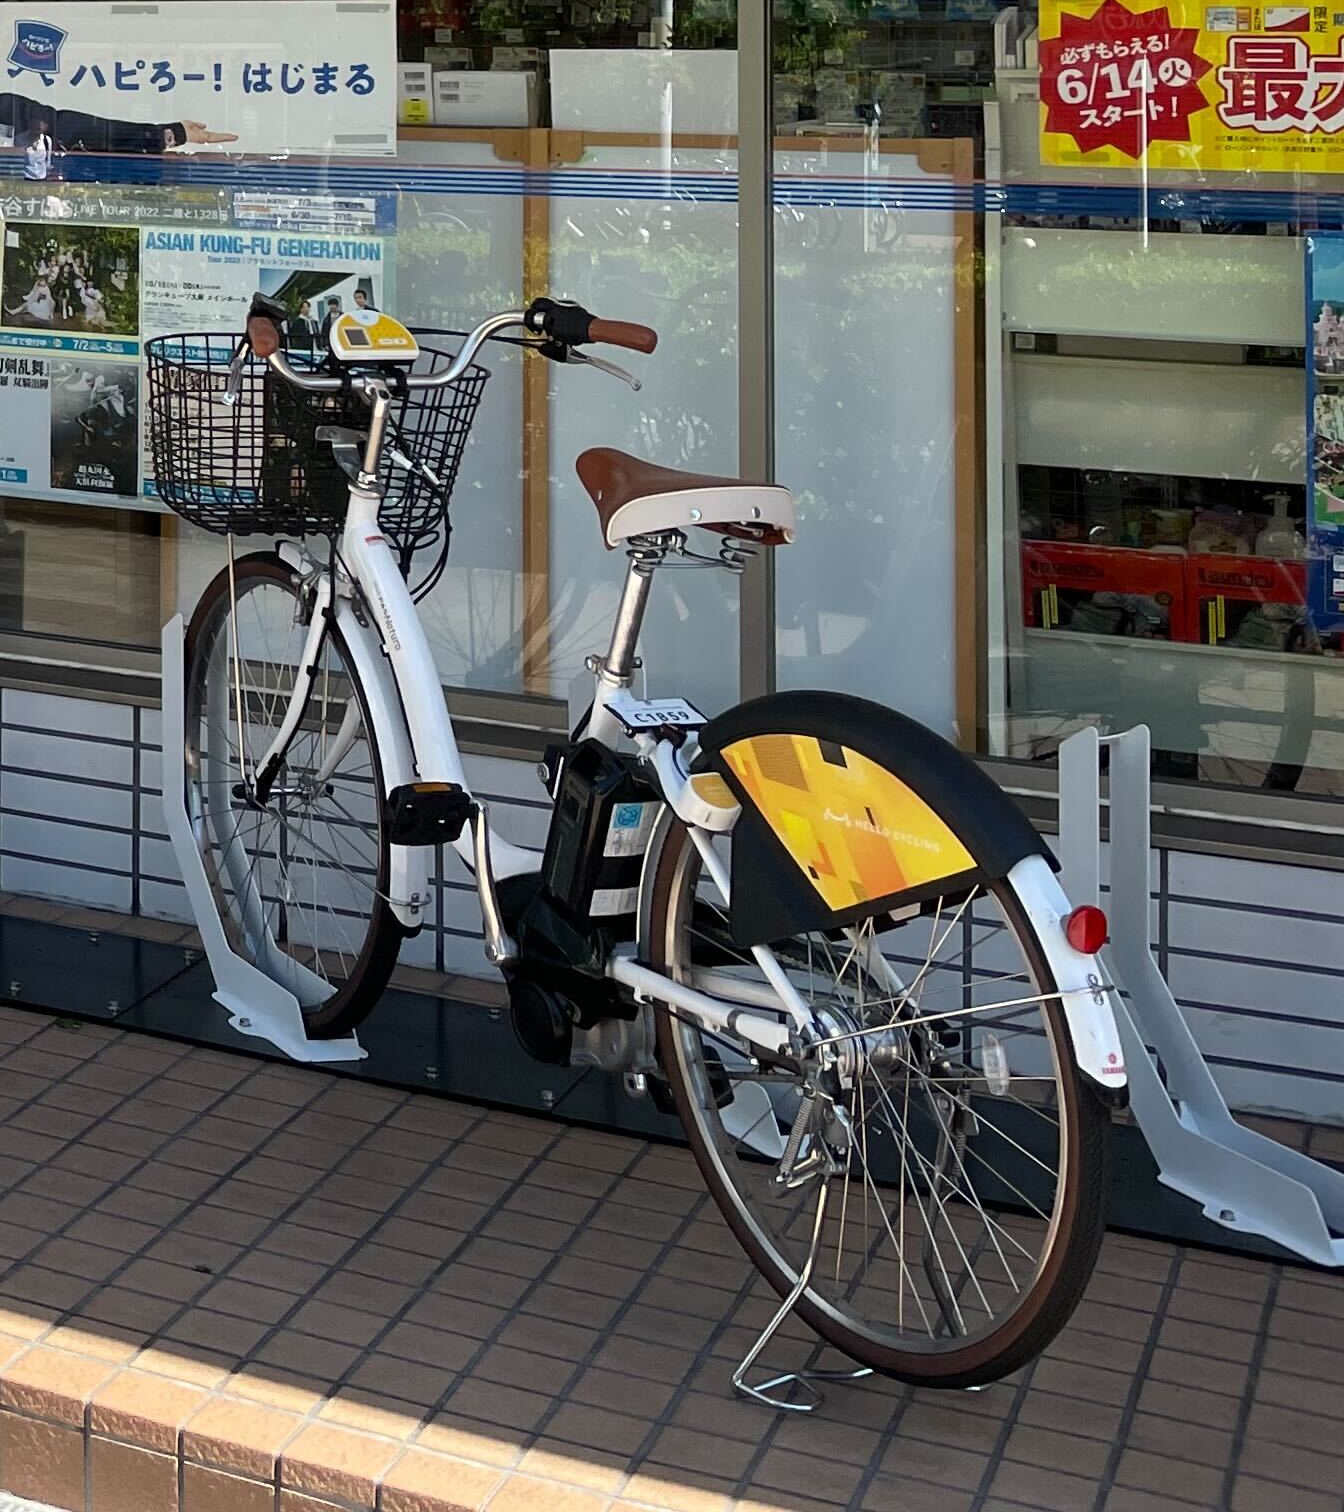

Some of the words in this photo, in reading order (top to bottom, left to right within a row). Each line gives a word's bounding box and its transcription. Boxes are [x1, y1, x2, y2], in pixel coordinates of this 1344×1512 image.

[1313, 6, 1329, 34] 限定
[1060, 33, 1171, 65] 必ずもらえる!
[70, 59, 222, 93] ハピろー!
[242, 61, 376, 96] はじまる
[1079, 96, 1180, 129] スタート!
[134, 206, 159, 218] 2022
[145, 231, 194, 252] ASIAN
[200, 234, 271, 256] KUNG-FU
[277, 237, 381, 261] GENERATION
[634, 711, 690, 723] C1859
[855, 818, 890, 838] HELLO
